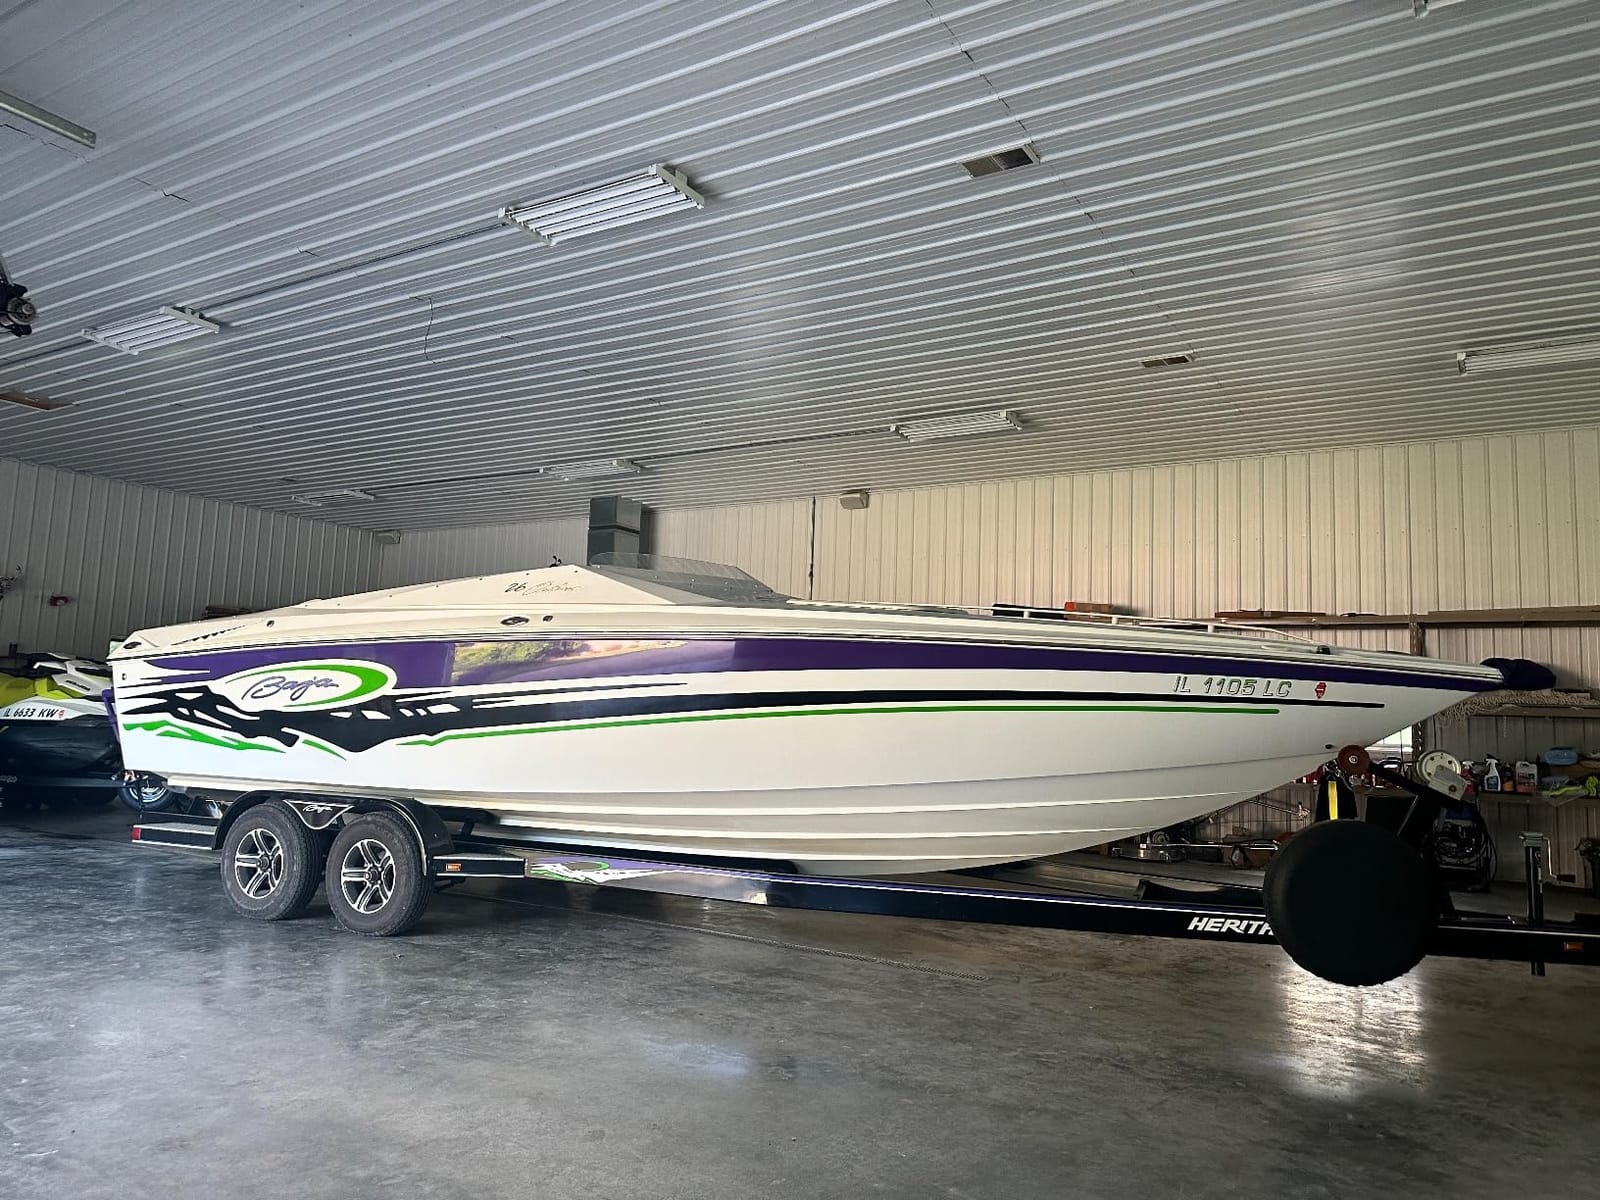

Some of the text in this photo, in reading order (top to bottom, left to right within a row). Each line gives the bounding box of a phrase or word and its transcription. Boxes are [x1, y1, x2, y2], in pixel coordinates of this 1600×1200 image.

[505, 582, 528, 593] 26
[241, 675, 339, 701] Baja
[1174, 675, 1292, 698] IL 1105 LC
[13, 708, 36, 717] 6633
[38, 708, 57, 718] KW
